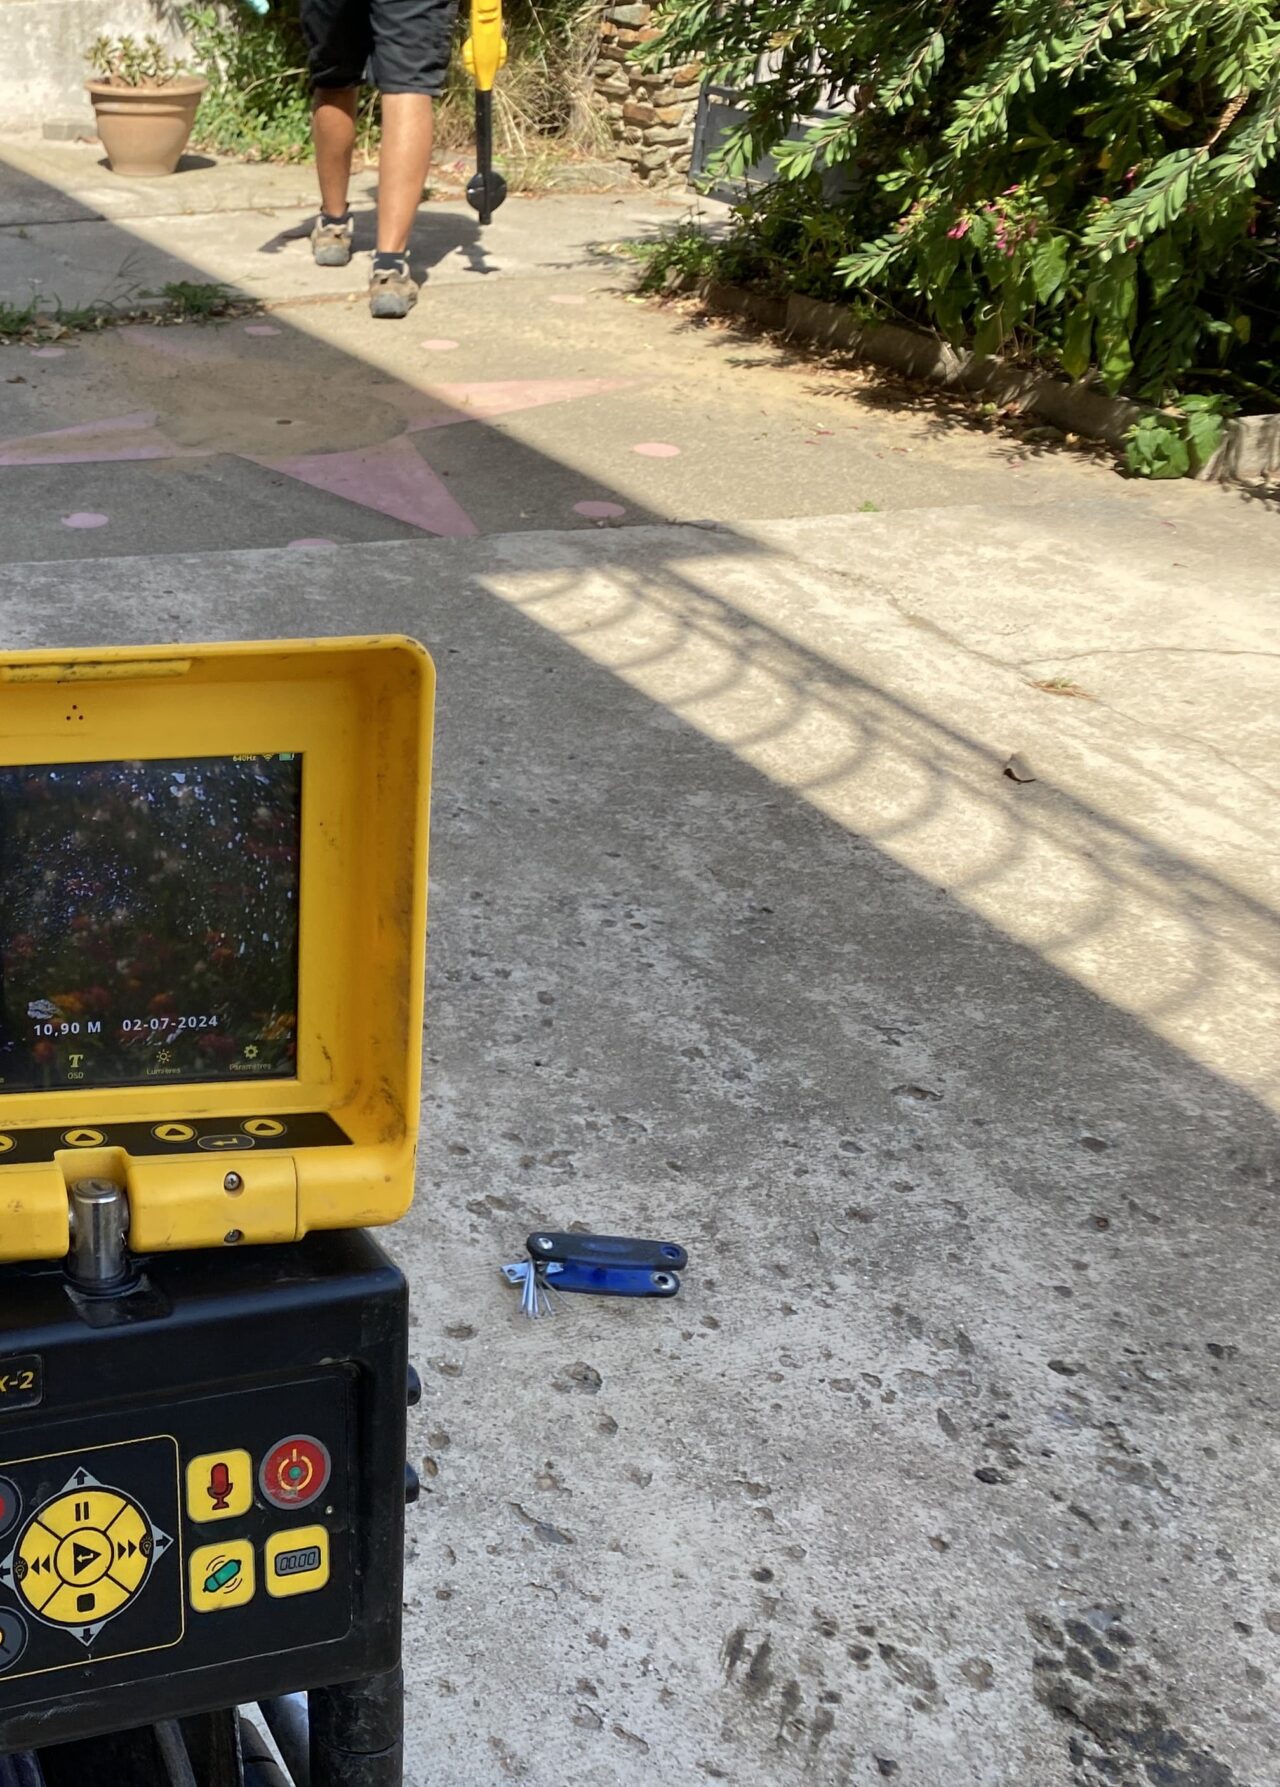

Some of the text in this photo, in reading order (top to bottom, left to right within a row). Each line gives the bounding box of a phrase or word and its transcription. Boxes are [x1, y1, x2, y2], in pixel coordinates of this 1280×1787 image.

[33, 1022, 80, 1037] 10,90
[87, 1021, 101, 1033] M
[122, 1015, 218, 1031] 02-07-2024
[67, 1072, 84, 1080] OSD
